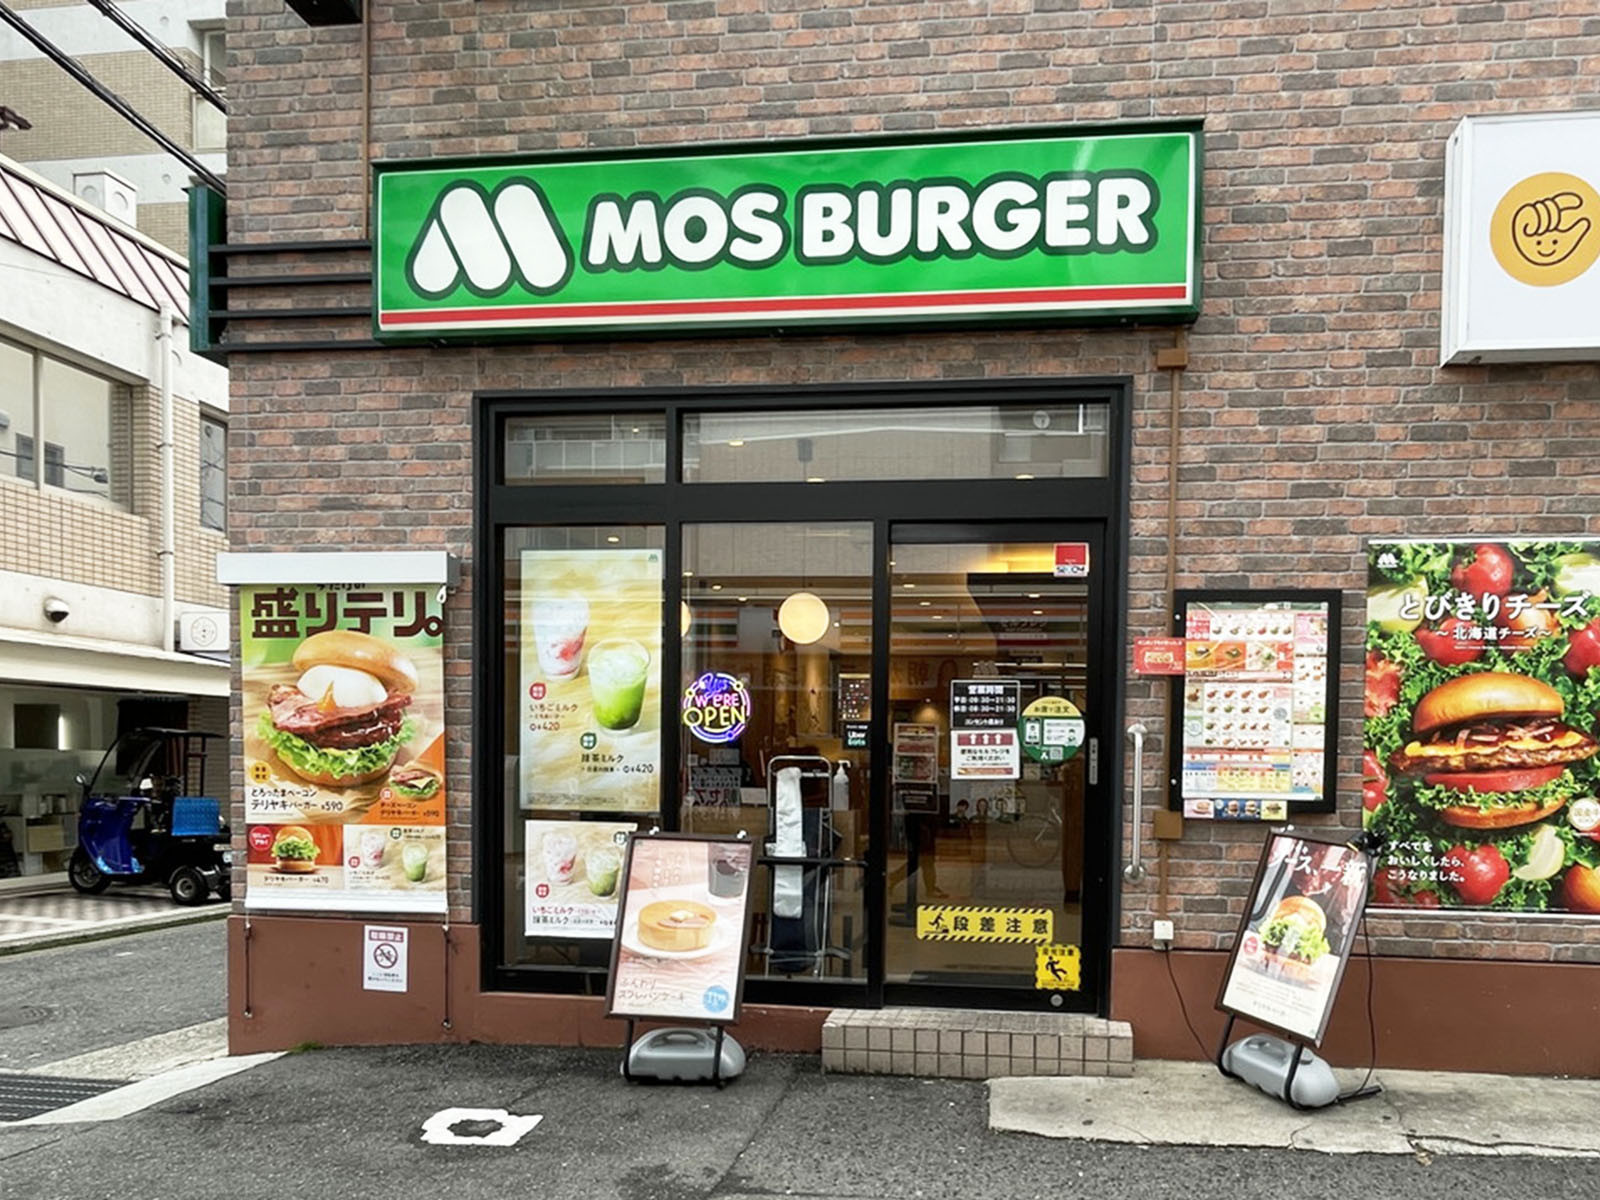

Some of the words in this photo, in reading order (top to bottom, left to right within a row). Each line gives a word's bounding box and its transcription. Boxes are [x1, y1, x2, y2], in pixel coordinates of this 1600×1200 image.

[585, 189, 787, 267] MOS
[799, 175, 1154, 260] BURGER
[1400, 589, 1592, 620] とびきりチーズ
[683, 706, 745, 726] OPEN
[1388, 840, 1433, 853] すべてを
[1388, 855, 1465, 868] おいしくしたら、
[1388, 869, 1465, 883] こうなりました。
[953, 915, 1049, 934] 段差注意
